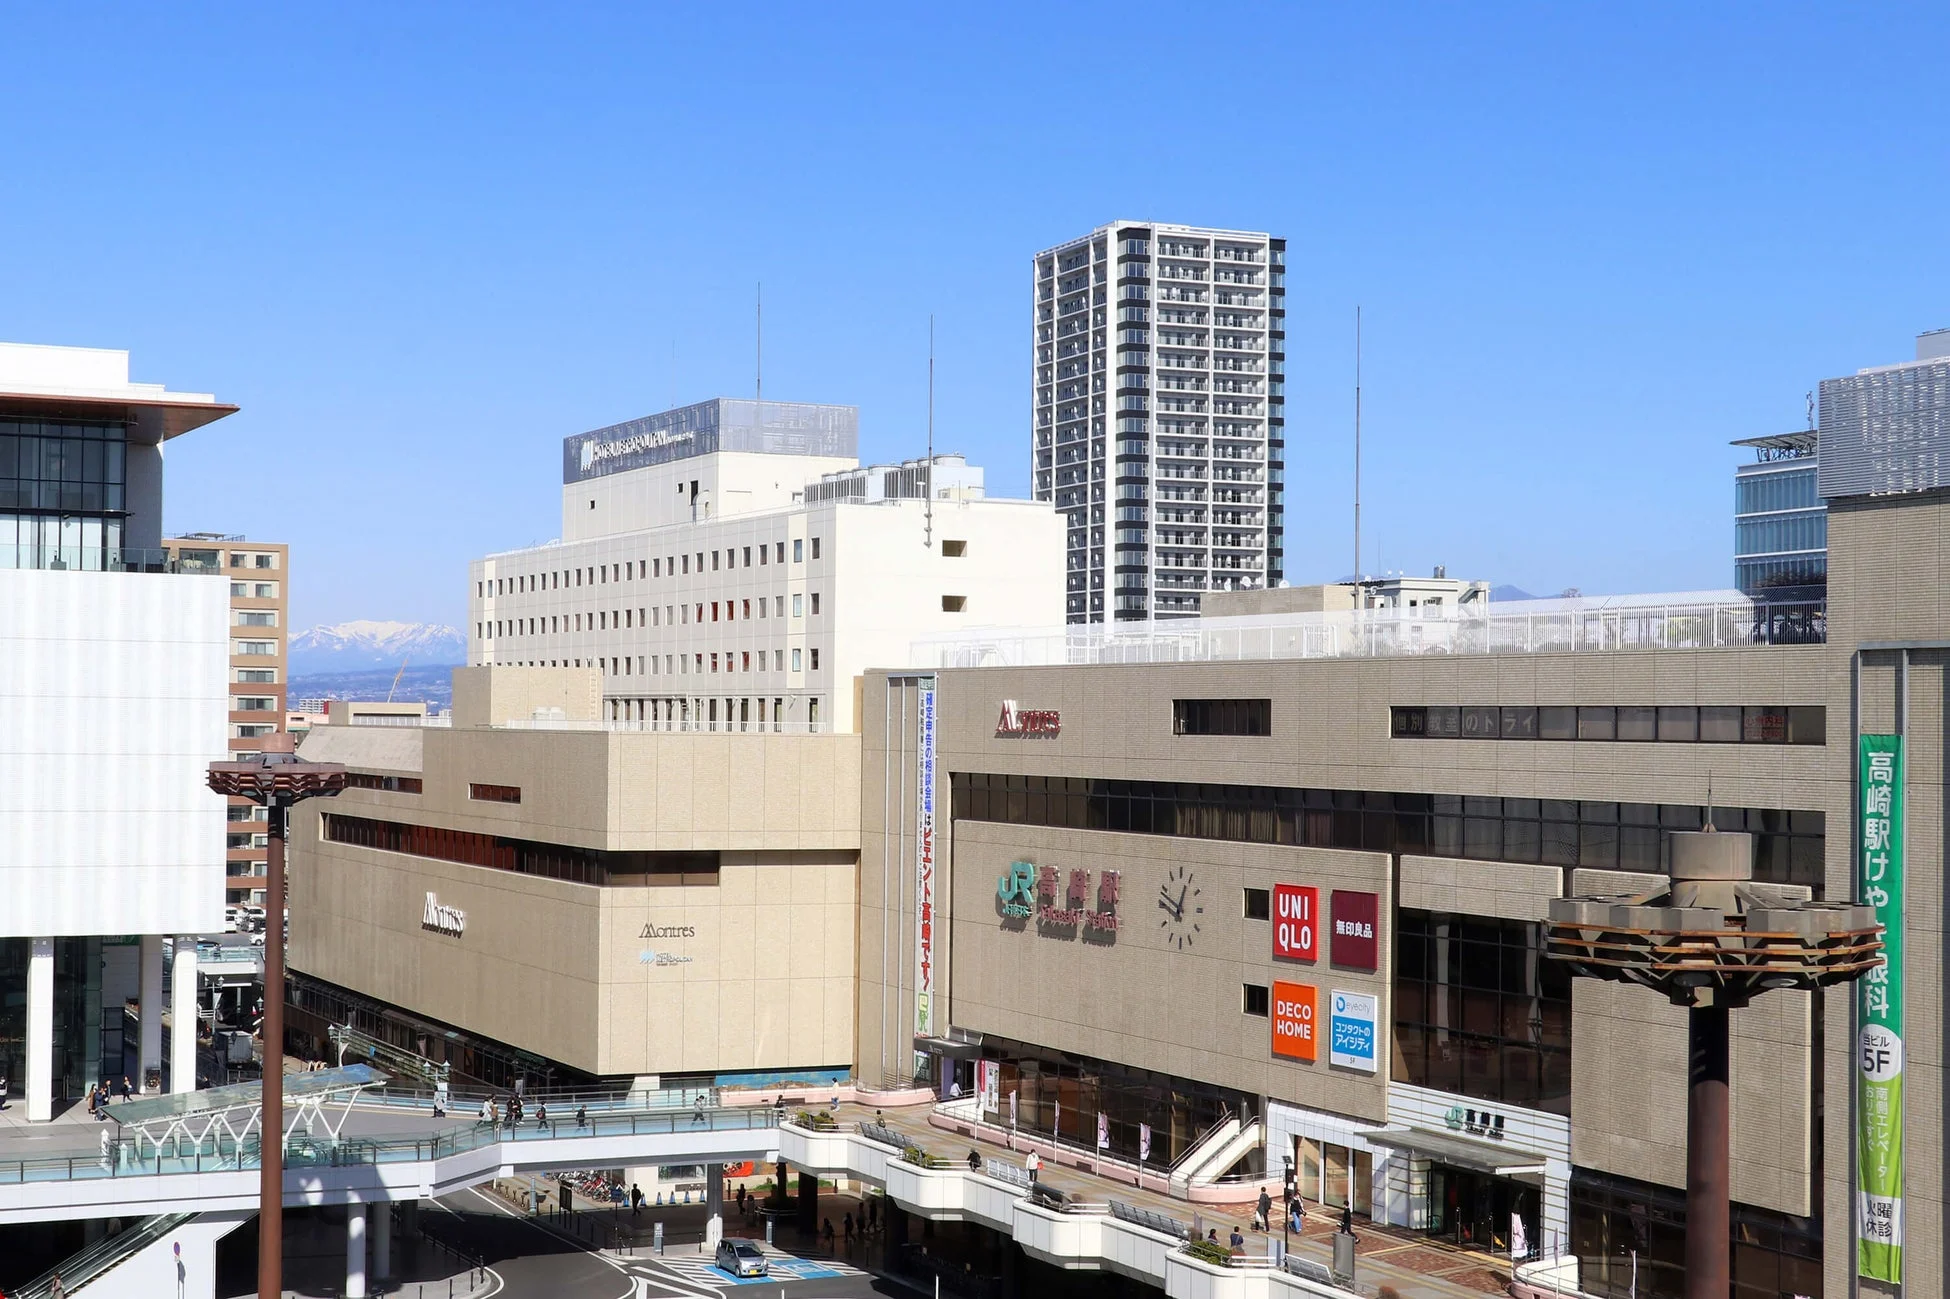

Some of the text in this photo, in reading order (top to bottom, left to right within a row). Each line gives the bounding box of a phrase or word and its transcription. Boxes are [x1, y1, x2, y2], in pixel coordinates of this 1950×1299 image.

[1394, 712, 1534, 733] 個別教室のトライ
[998, 861, 1034, 902] JR
[1279, 893, 1309, 920] UNI
[638, 922, 696, 938] Montres
[1279, 923, 1312, 952] QLO
[1336, 919, 1373, 939] 無印良品
[1277, 1000, 1312, 1020] DECO
[1277, 1019, 1311, 1040] HOME
[1335, 1022, 1371, 1037] コンタクトの
[1335, 1034, 1371, 1053] アイシティ
[1863, 1048, 1890, 1073] 5F
[1865, 1085, 1874, 1151] おりてすぐ
[1876, 1087, 1889, 1192] 南側エレベーター
[1867, 1200, 1892, 1218] 火曜
[1866, 1218, 1892, 1237] 休診
